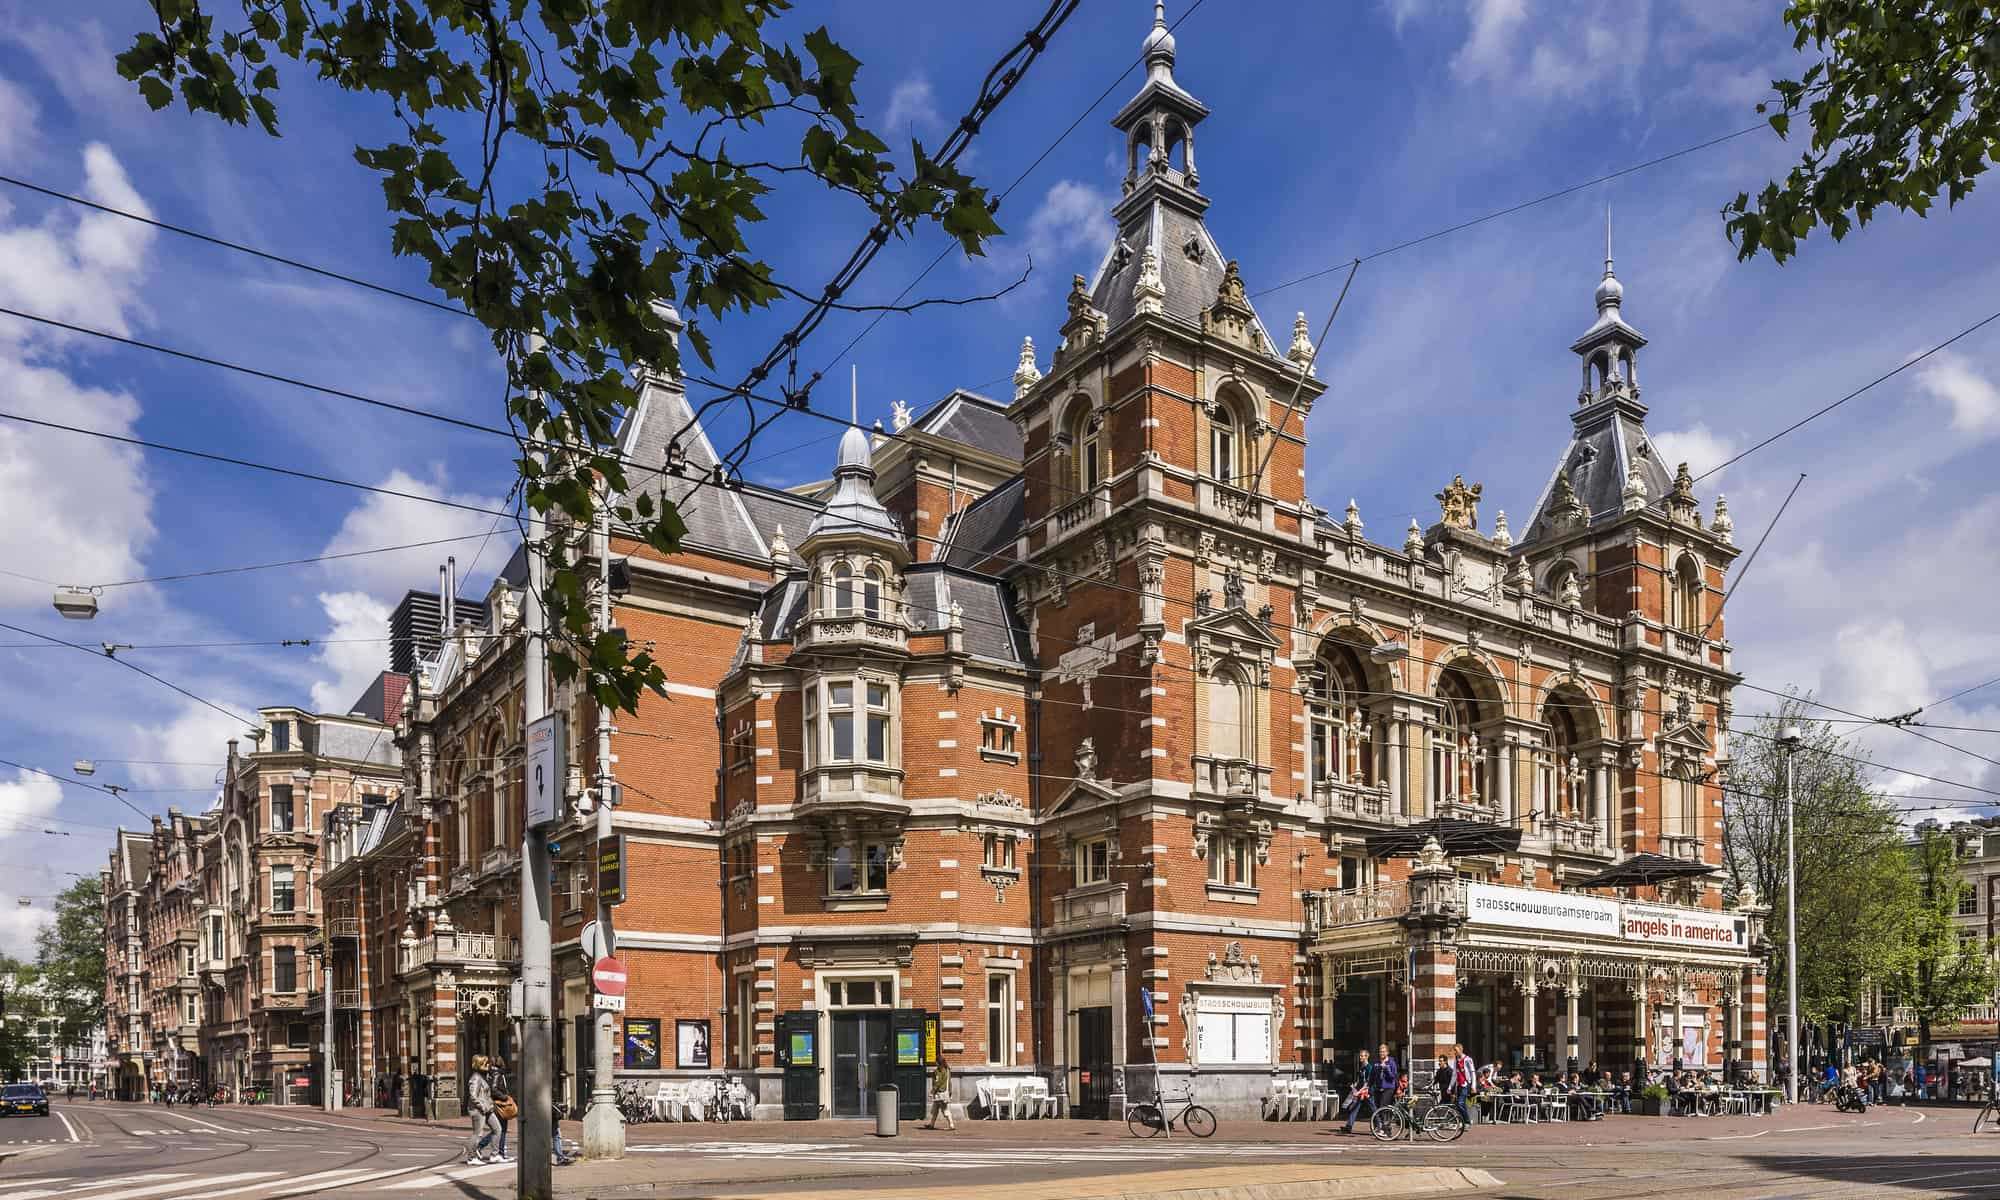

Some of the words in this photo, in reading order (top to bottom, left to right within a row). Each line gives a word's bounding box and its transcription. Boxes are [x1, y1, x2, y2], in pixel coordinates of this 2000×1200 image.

[1627, 918, 1669, 938] angels
[1671, 919, 1682, 937] in
[1684, 924, 1732, 942] america
